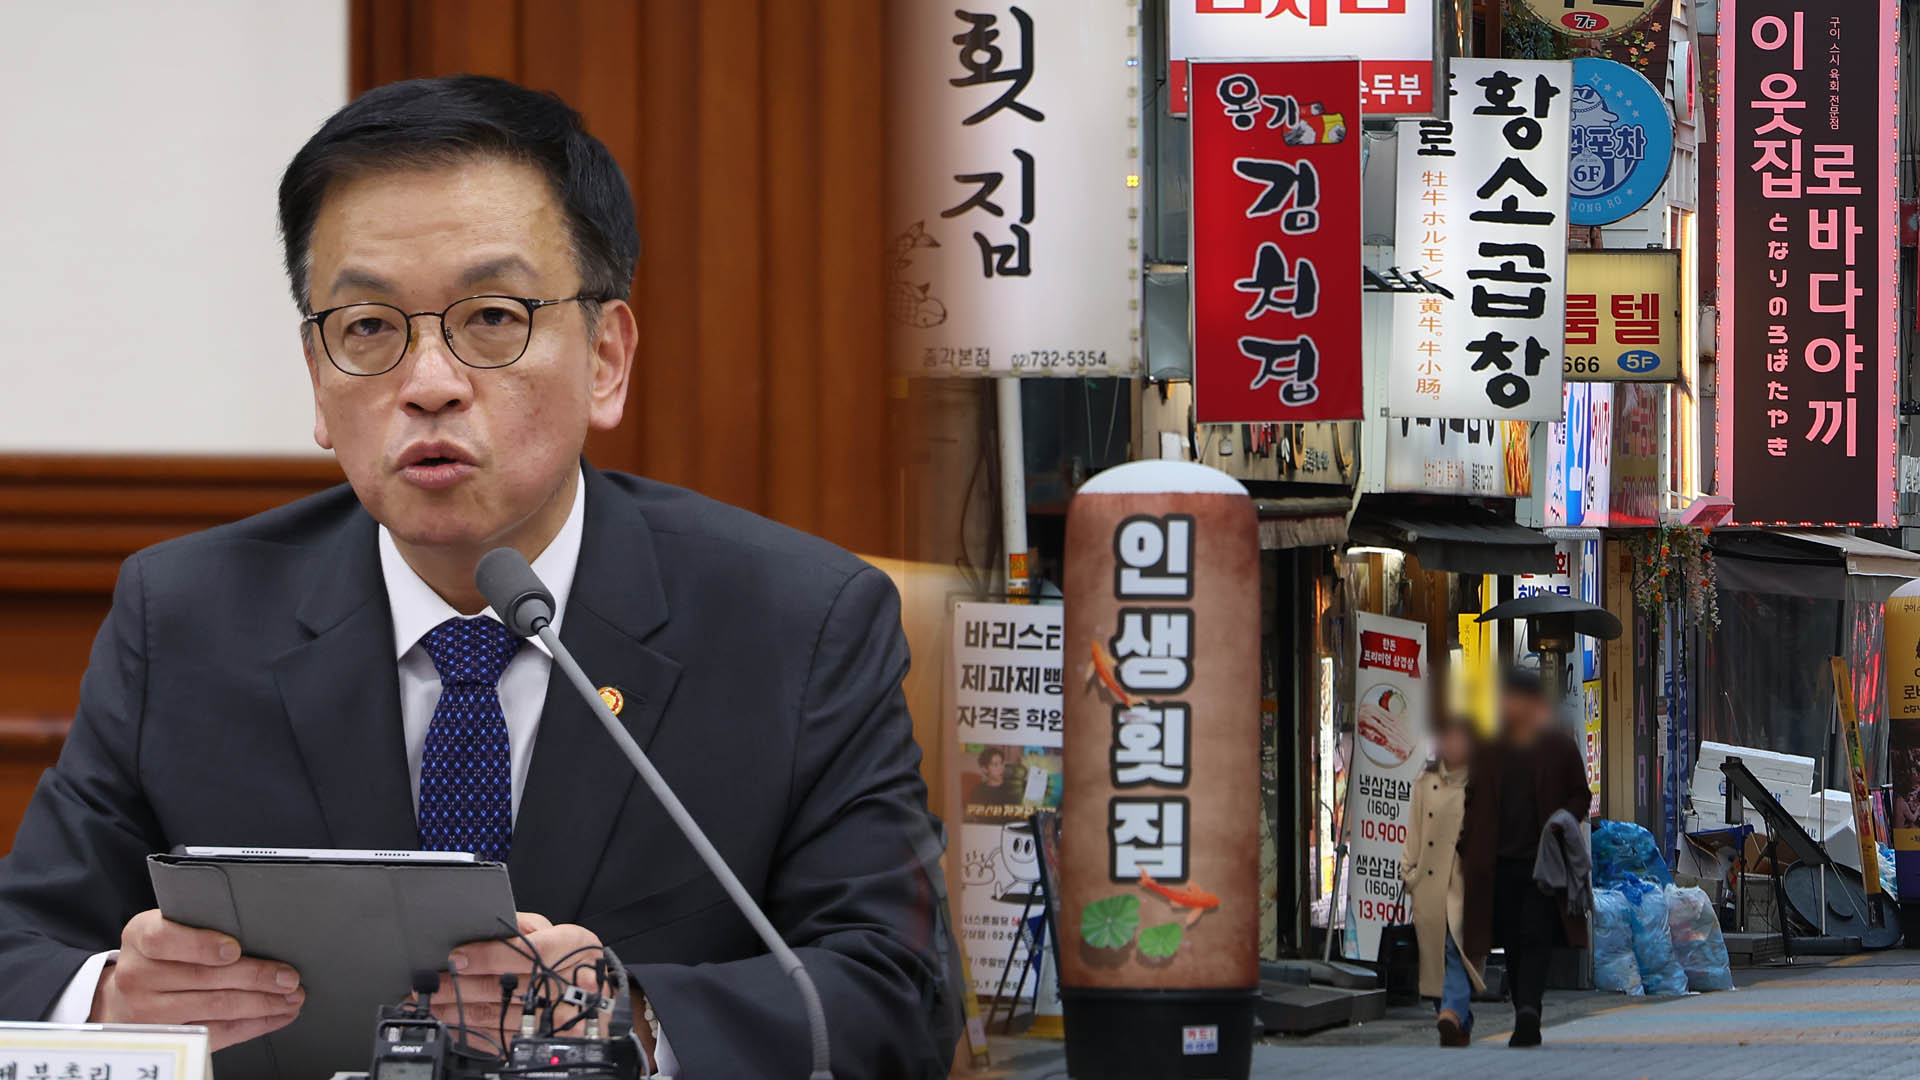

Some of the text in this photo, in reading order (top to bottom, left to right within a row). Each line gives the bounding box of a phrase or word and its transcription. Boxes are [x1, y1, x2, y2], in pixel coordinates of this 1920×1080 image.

[1574, 15, 1597, 29] 7F
[1361, 74, 1421, 104] 두부
[1829, 17, 1840, 130] 구이 스시 육회 전문점
[1217, 74, 1299, 130] 옹기
[1751, 12, 1806, 199] 이웃집
[941, 6, 1045, 279] 횟집
[1573, 165, 1600, 182] 6F
[1465, 70, 1561, 409] 황소곱창
[1806, 145, 1864, 457] 로바다야끼
[1767, 213, 1790, 457] となりのろばたやき
[1626, 354, 1653, 369] 5F
[958, 706, 1020, 730] 자격증
[1112, 517, 1192, 881] 인생횟집
[1638, 616, 1647, 807] BAR
[1359, 774, 1412, 801] 냉삼겹살
[1367, 799, 1400, 820] (160g)
[1365, 878, 1399, 900] (160g)
[391, 1045, 423, 1053] SONY
